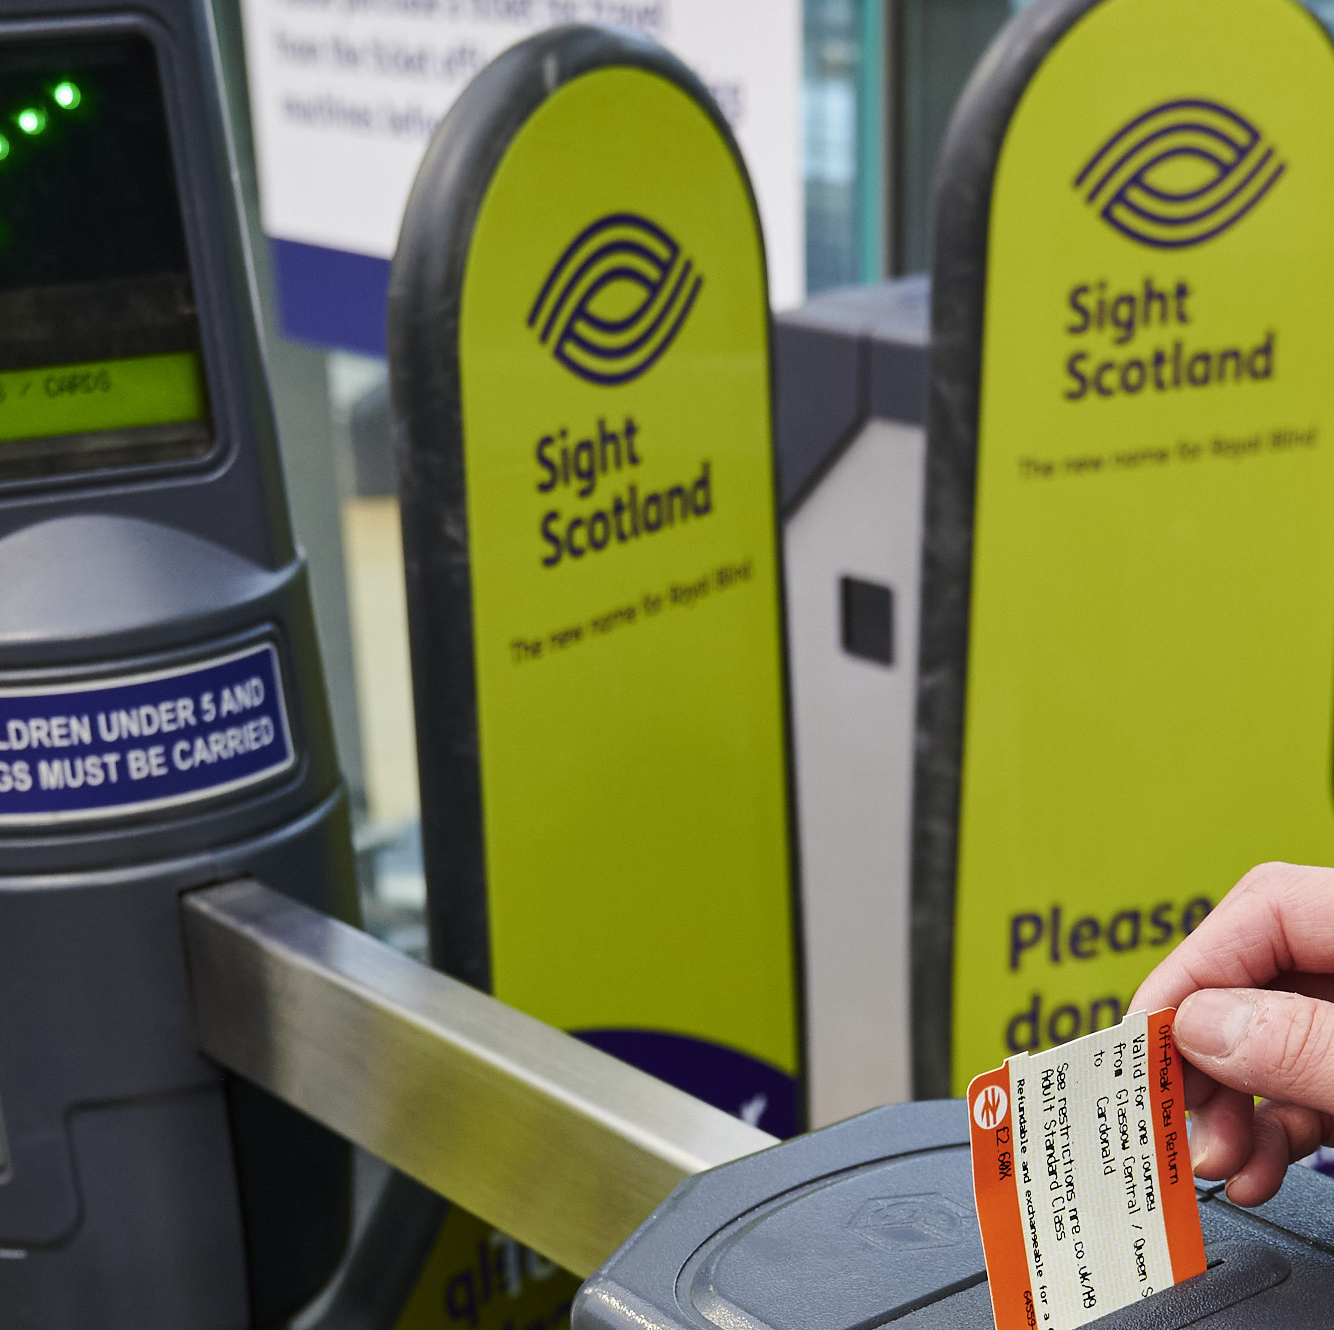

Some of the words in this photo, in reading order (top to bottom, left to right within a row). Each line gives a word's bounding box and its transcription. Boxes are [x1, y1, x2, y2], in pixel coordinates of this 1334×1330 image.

[1065, 277, 1192, 346] Sight
[43, 369, 113, 398] CARDS
[1063, 326, 1277, 402] Scotland
[535, 415, 641, 498] Sight
[540, 458, 713, 569] Scotland
[97, 696, 195, 742] UNDER
[201, 691, 217, 722] 5
[220, 676, 265, 718] AND
[38, 752, 121, 791] MUST
[127, 745, 168, 781] BE
[172, 715, 275, 772] CARRIED
[1004, 991, 1124, 1056] don
[1056, 1062, 1069, 1091] See
[1093, 1049, 1106, 1068] to
[1113, 1041, 1127, 1078] from
[1132, 1033, 1146, 1079] Valid
[1159, 1024, 1172, 1093] Off-Peak
[1017, 1078, 1029, 1154] Refundable
[1041, 1068, 1056, 1112] Adult
[1115, 1088, 1130, 1151] Glasgow
[1134, 1085, 1147, 1111] for
[1161, 1098, 1174, 1127] Day
[1043, 1119, 1063, 1192] Standard
[1058, 1097, 1076, 1202] restrictions
[1096, 1096, 1117, 1176] Cardonald
[1138, 1119, 1149, 1146] one
[1165, 1131, 1179, 1185] Return
[1022, 1161, 1032, 1184] and
[1122, 1155, 1141, 1215] Central
[1141, 1153, 1156, 1212] journey
[1025, 1190, 1044, 1277] exchangeable
[1051, 1195, 1066, 1241] Class
[1134, 1237, 1148, 1283] Queen
[1039, 1285, 1048, 1305] for
[1043, 1312, 1051, 1321] a
